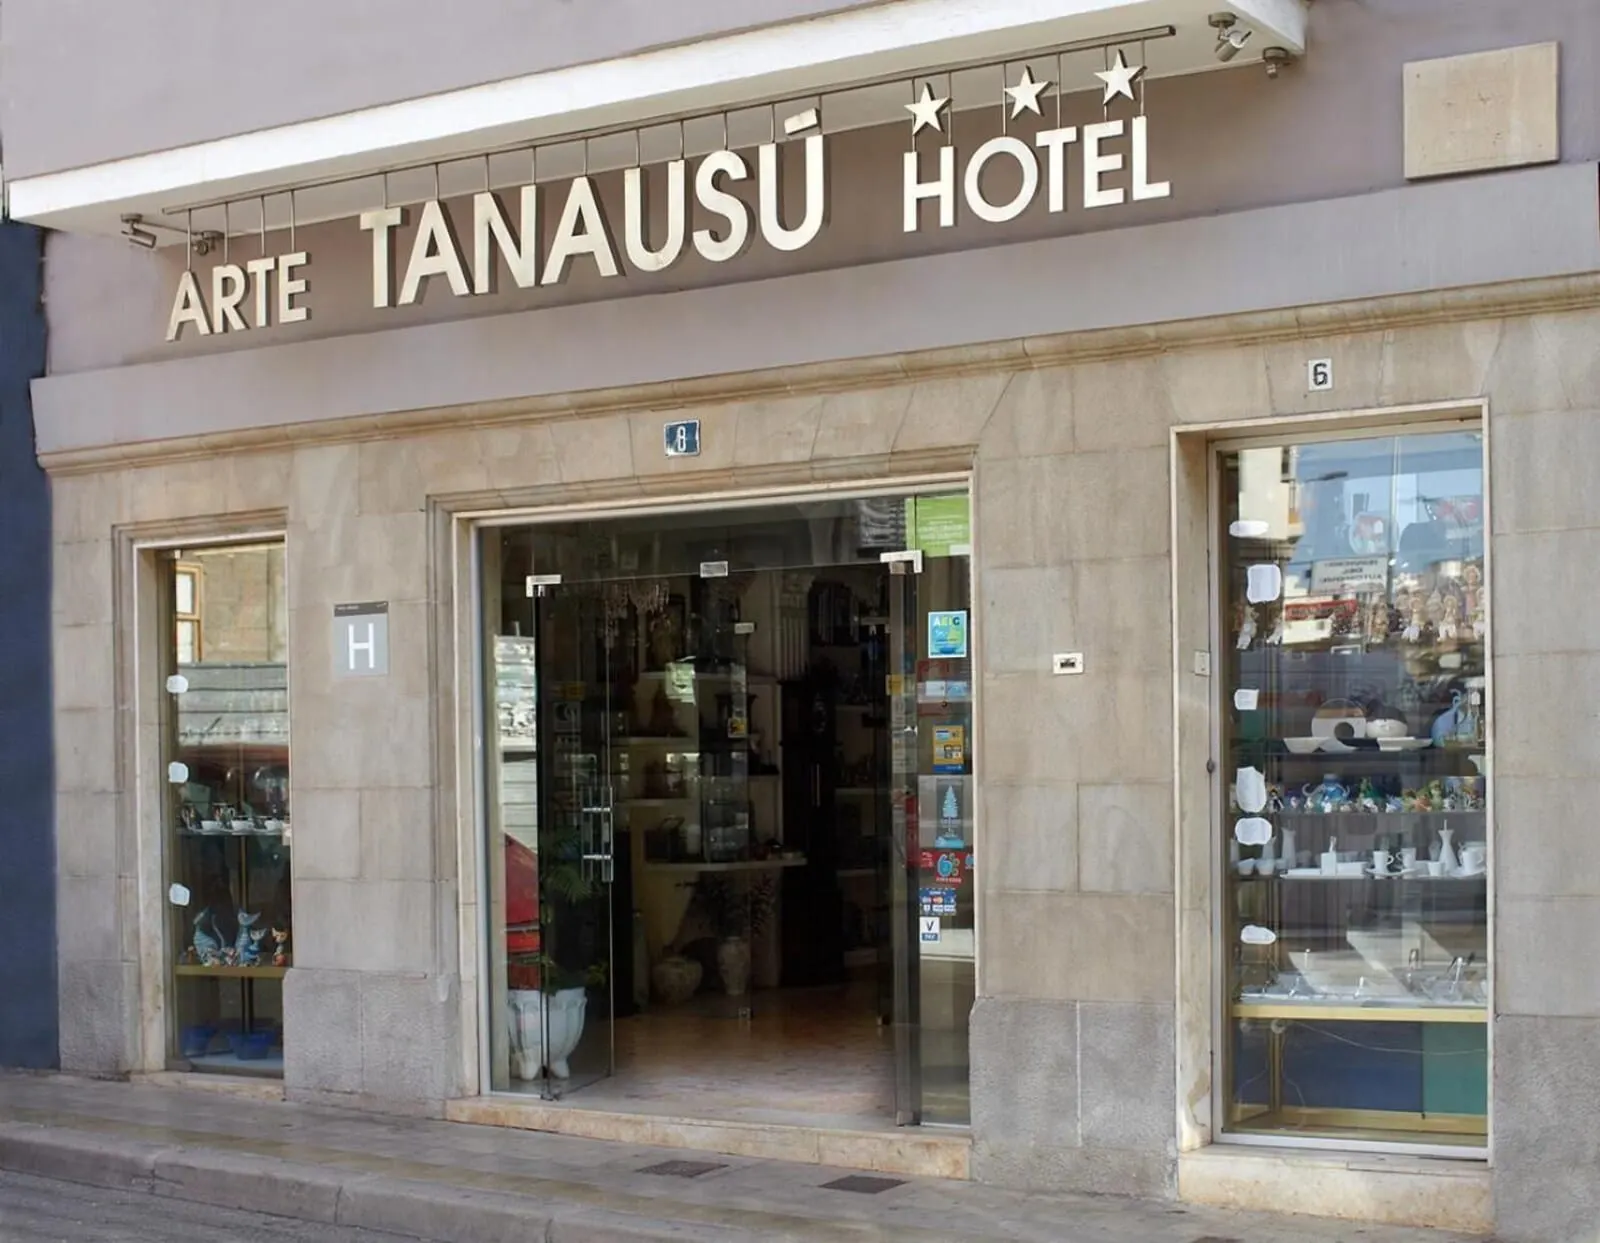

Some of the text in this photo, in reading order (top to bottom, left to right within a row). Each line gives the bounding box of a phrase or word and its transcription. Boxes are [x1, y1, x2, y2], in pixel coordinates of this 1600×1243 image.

[165, 108, 1171, 342] ARTE TANAUSÚ HOTEL
[1313, 362, 1328, 386] 6
[677, 425, 687, 452] 8
[348, 623, 375, 670] H
